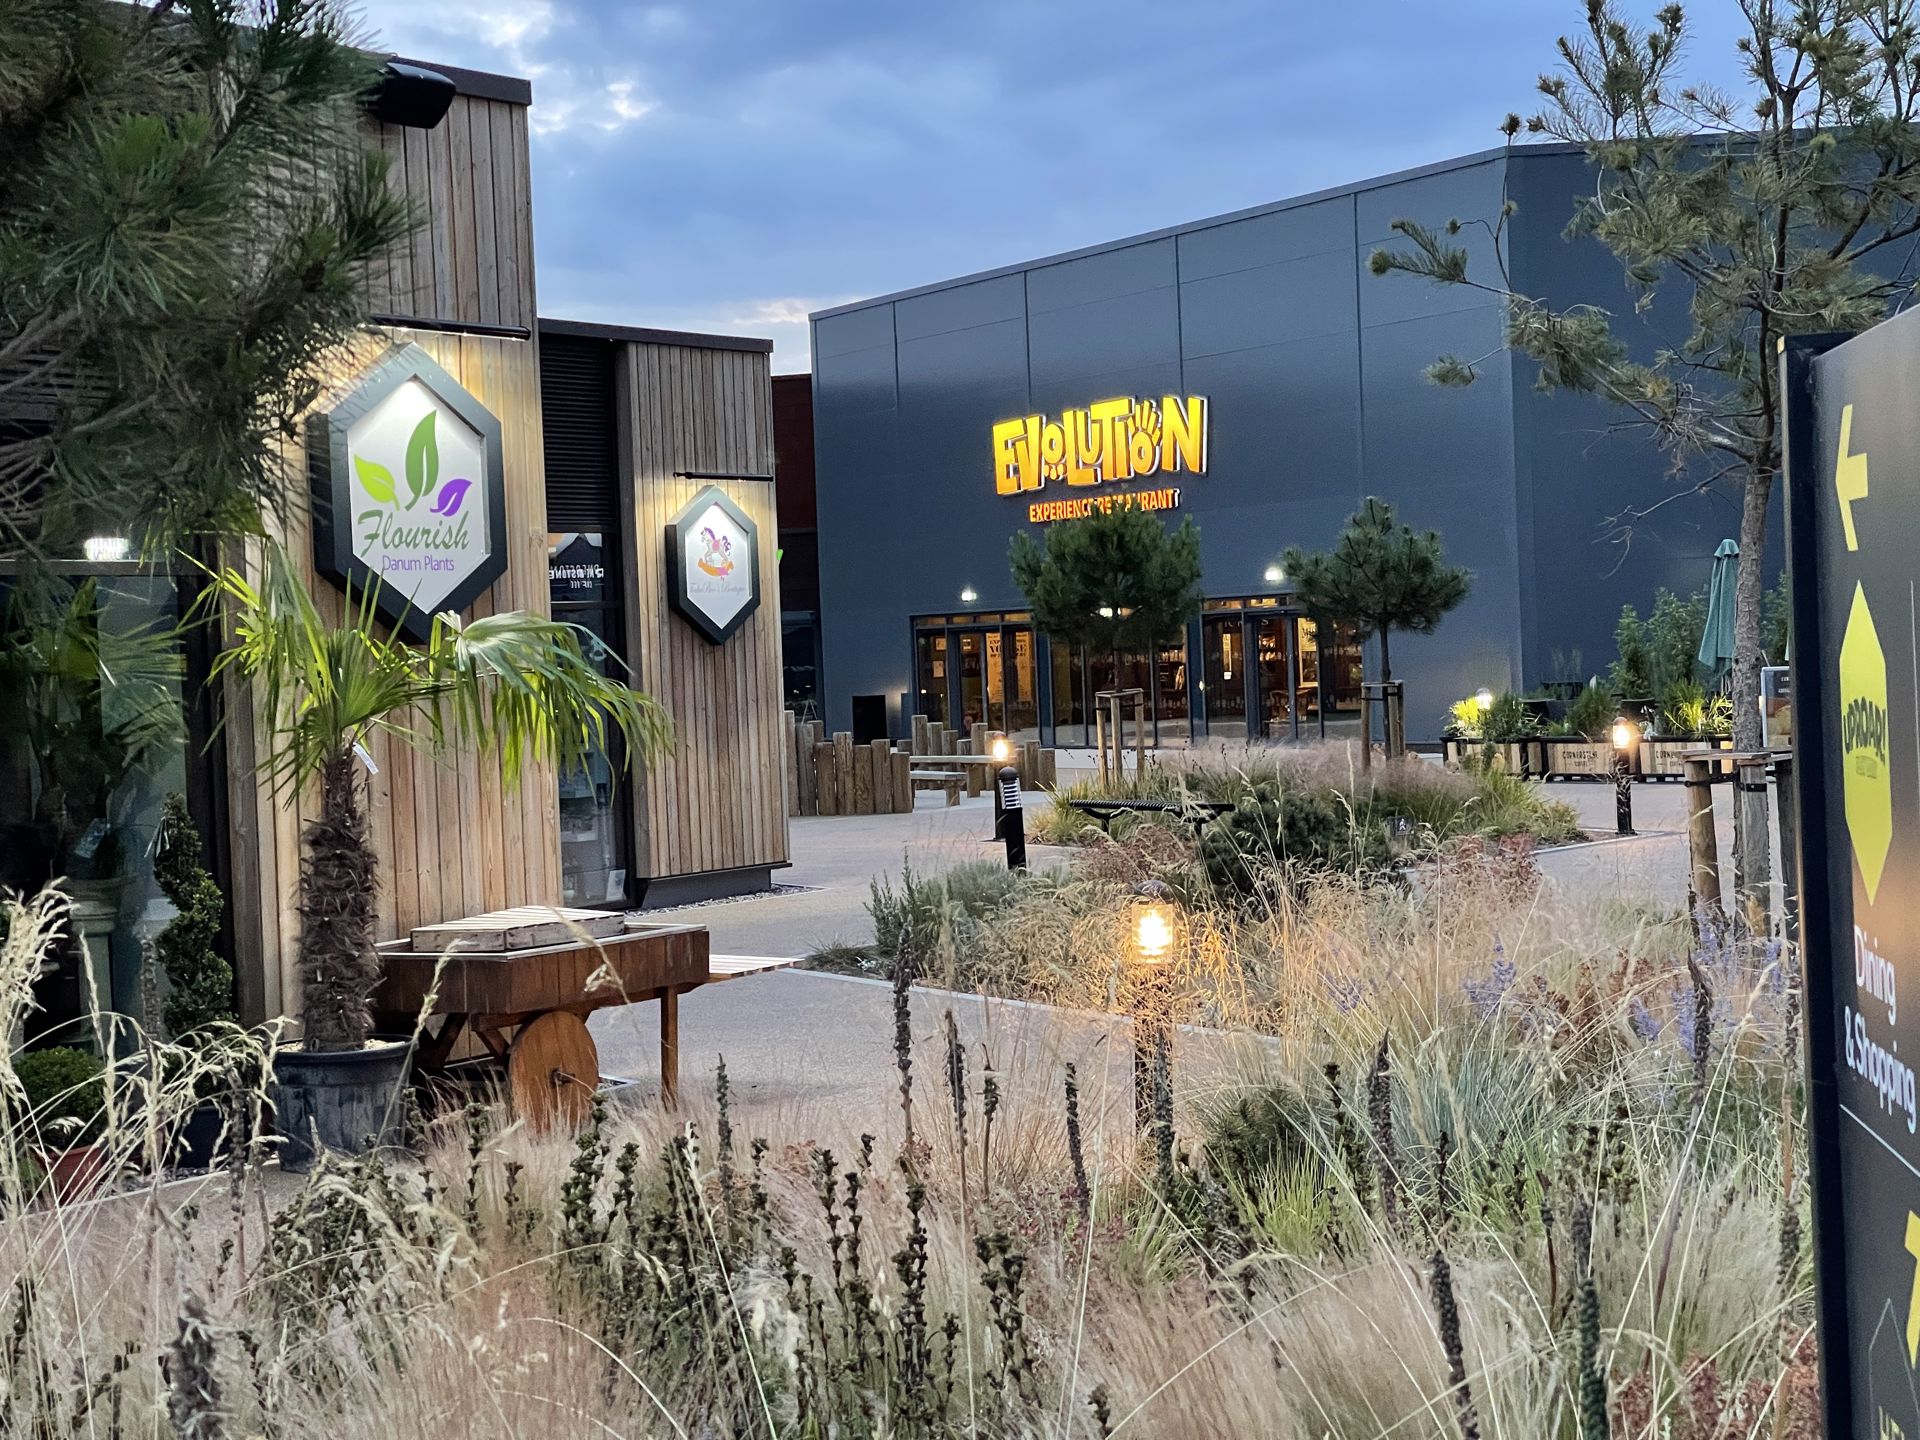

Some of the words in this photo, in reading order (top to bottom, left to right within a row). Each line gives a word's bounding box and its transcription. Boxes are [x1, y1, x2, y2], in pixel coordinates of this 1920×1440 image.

[992, 395, 1208, 496] EVOLUTION
[357, 508, 470, 558] Flourish
[382, 555, 421, 571] Danum
[424, 555, 455, 571] Plants
[1853, 924, 1897, 1026] Dining
